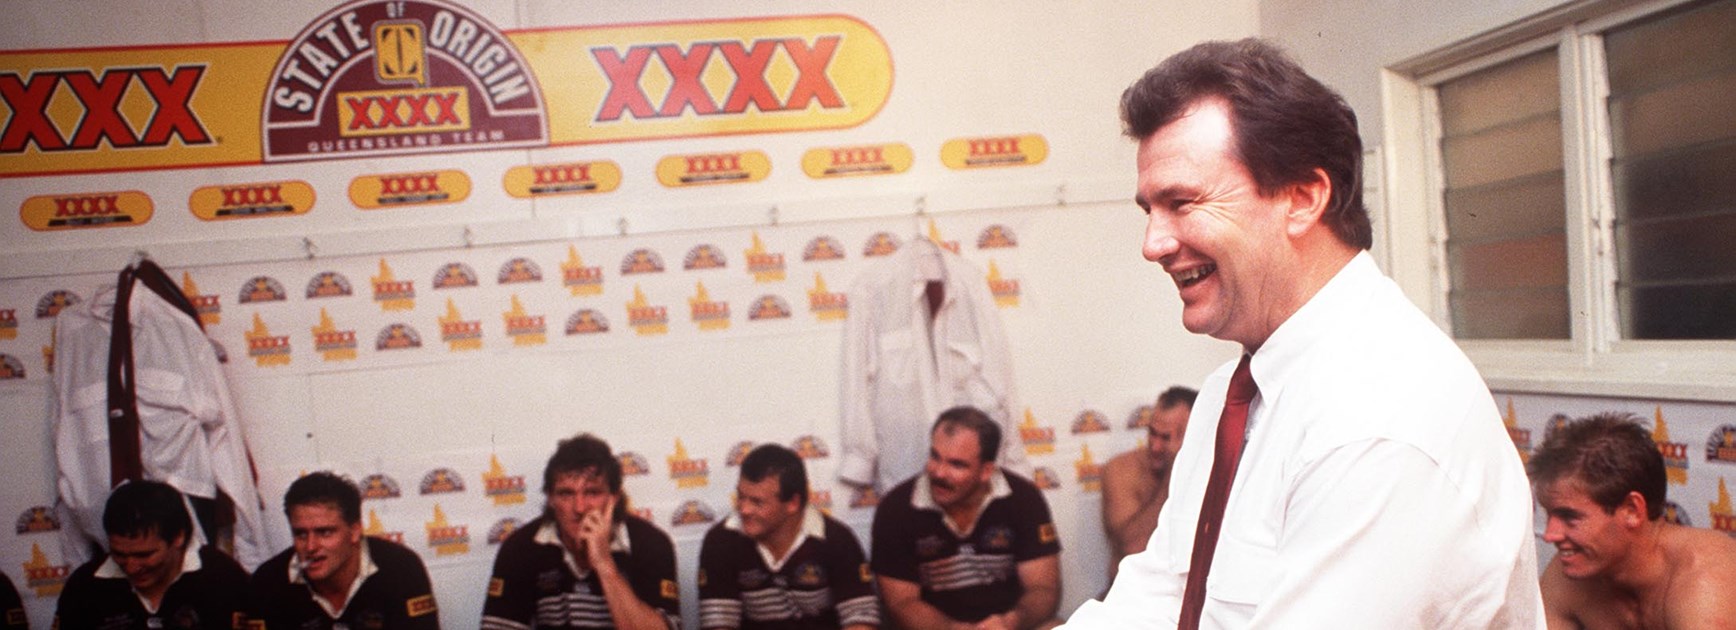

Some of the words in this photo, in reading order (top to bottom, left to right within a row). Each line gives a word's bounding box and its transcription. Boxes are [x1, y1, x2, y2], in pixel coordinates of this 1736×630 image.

[273, 11, 370, 113] STATE
[429, 11, 530, 105] ORIGIN
[590, 36, 847, 122] XXXX
[346, 92, 461, 130] XXXX
[307, 133, 443, 152] QUEENSLAND
[453, 130, 505, 144] TEAM
[381, 174, 438, 195] XXXX
[534, 165, 591, 184] XXXX
[55, 195, 120, 217] XXXX
[222, 185, 282, 206] XXXX
